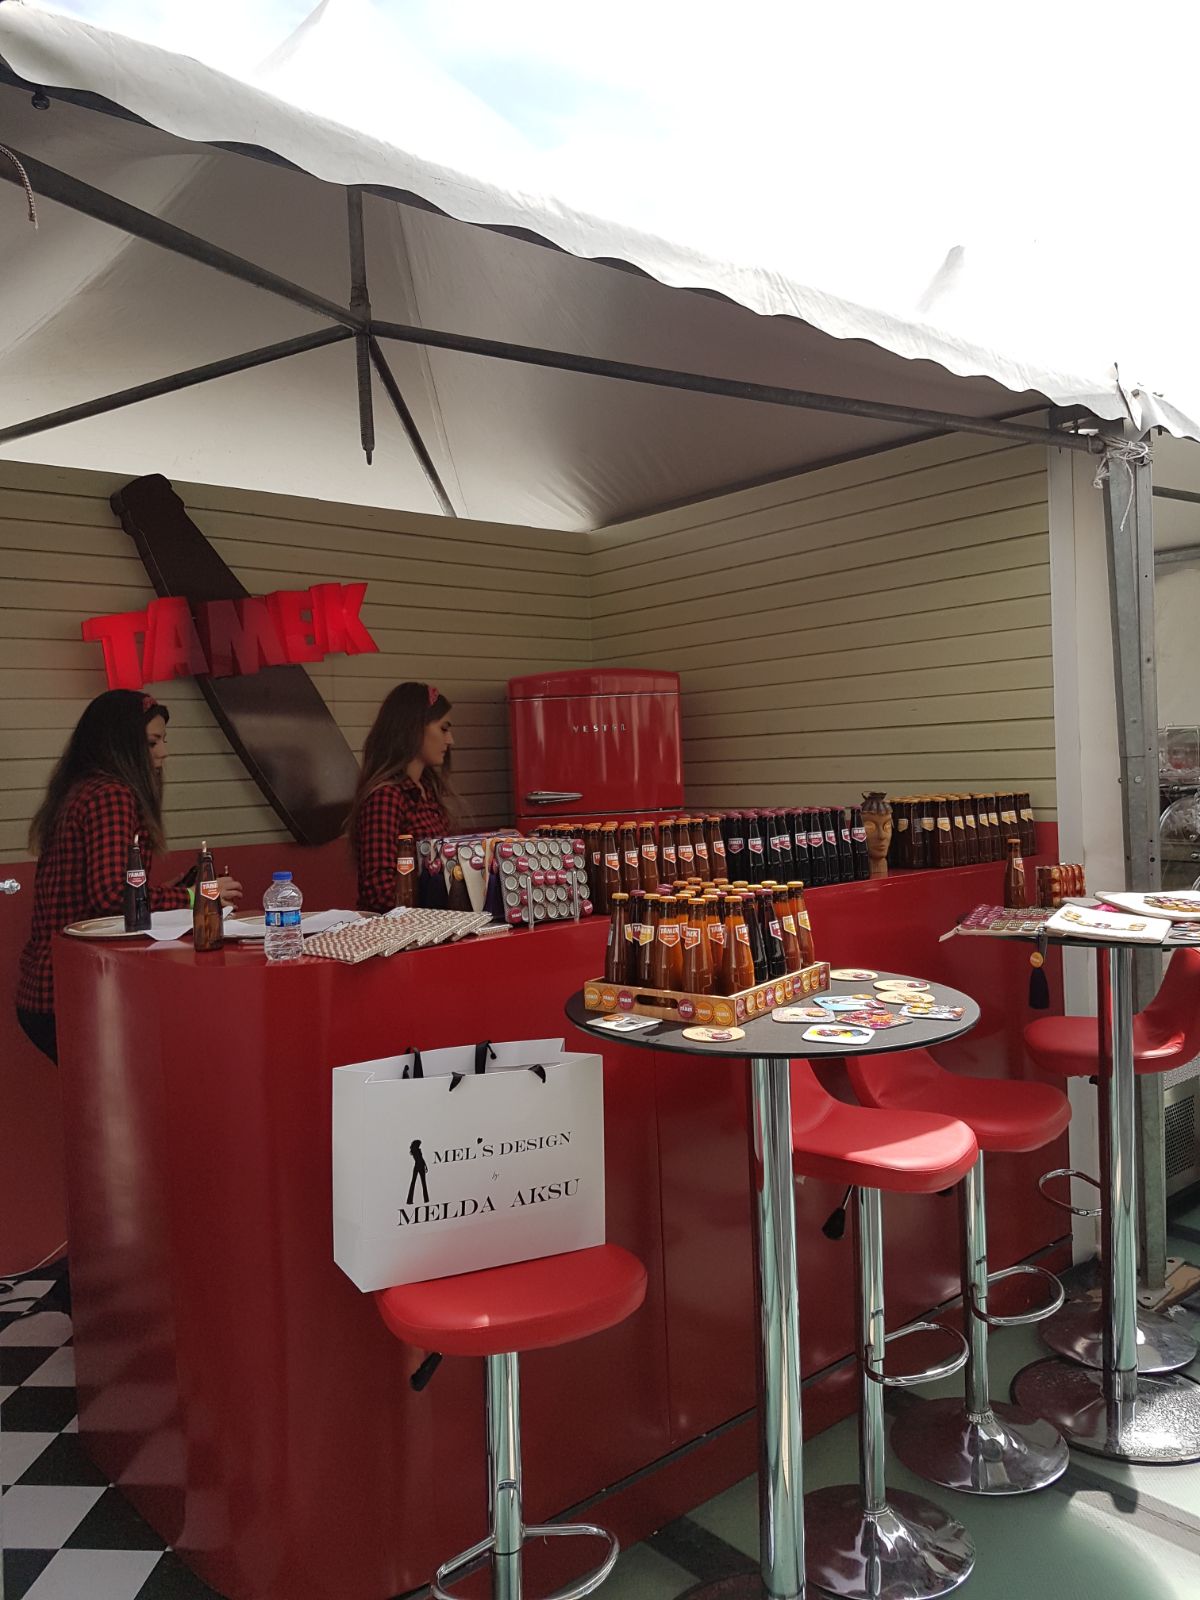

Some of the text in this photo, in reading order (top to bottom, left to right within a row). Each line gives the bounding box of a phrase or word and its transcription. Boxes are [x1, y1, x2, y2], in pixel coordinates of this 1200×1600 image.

[81, 583, 380, 690] TAMEK
[499, 1131, 572, 1156] DESIGN
[397, 1178, 580, 1226] MELDA AKSU
